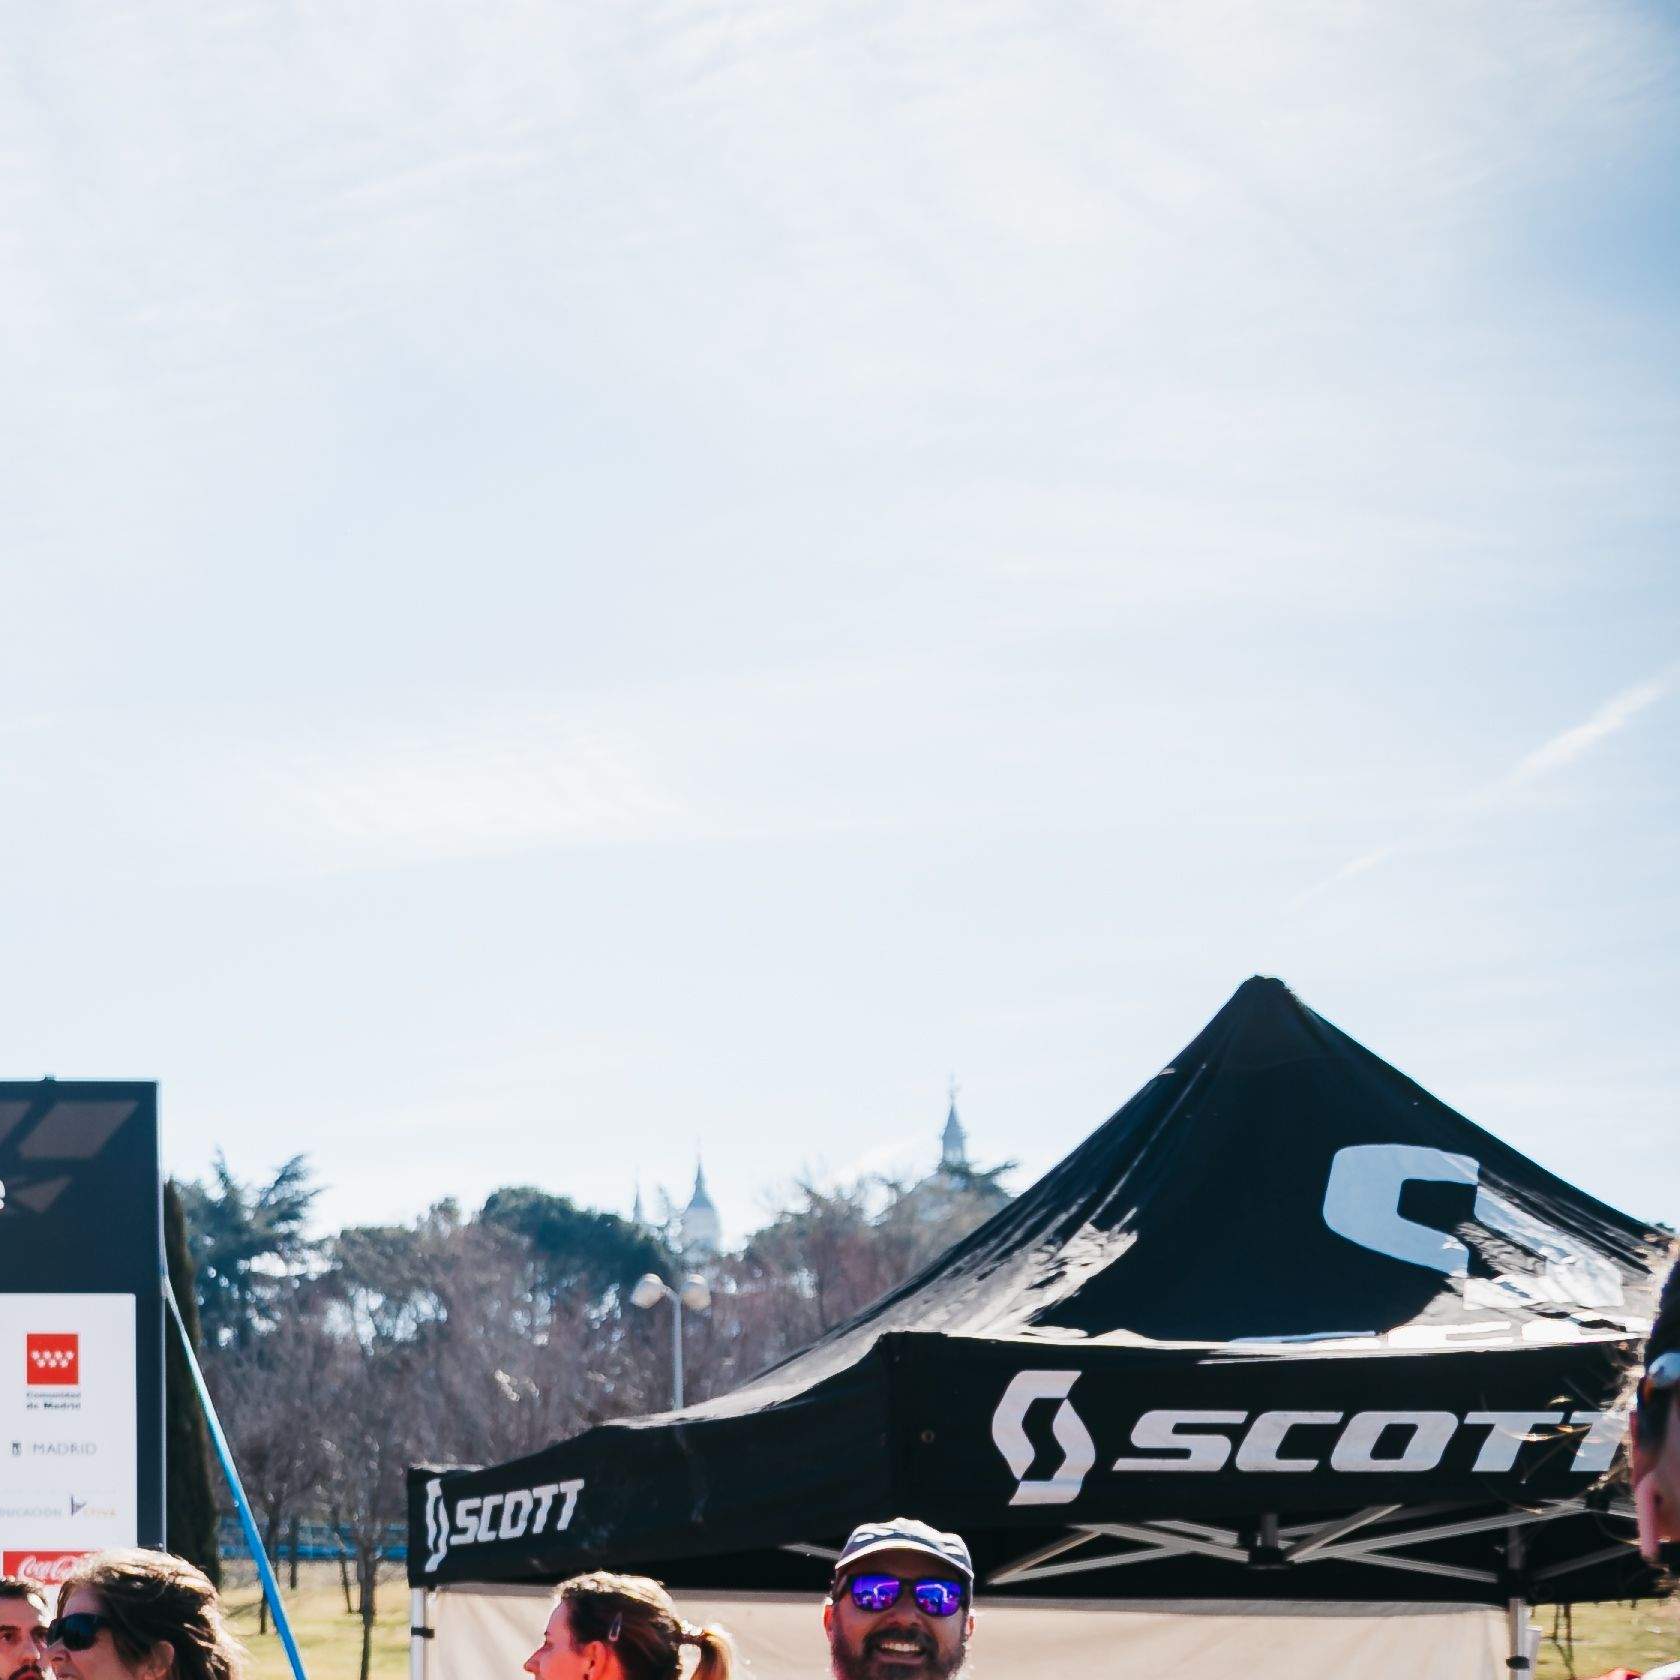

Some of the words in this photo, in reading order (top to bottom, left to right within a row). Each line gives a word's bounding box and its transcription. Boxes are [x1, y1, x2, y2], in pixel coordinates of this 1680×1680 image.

[32, 1442, 98, 1456] MADRID
[1112, 1409, 1630, 1473] SCOTT
[450, 1478, 586, 1546] SCOTT
